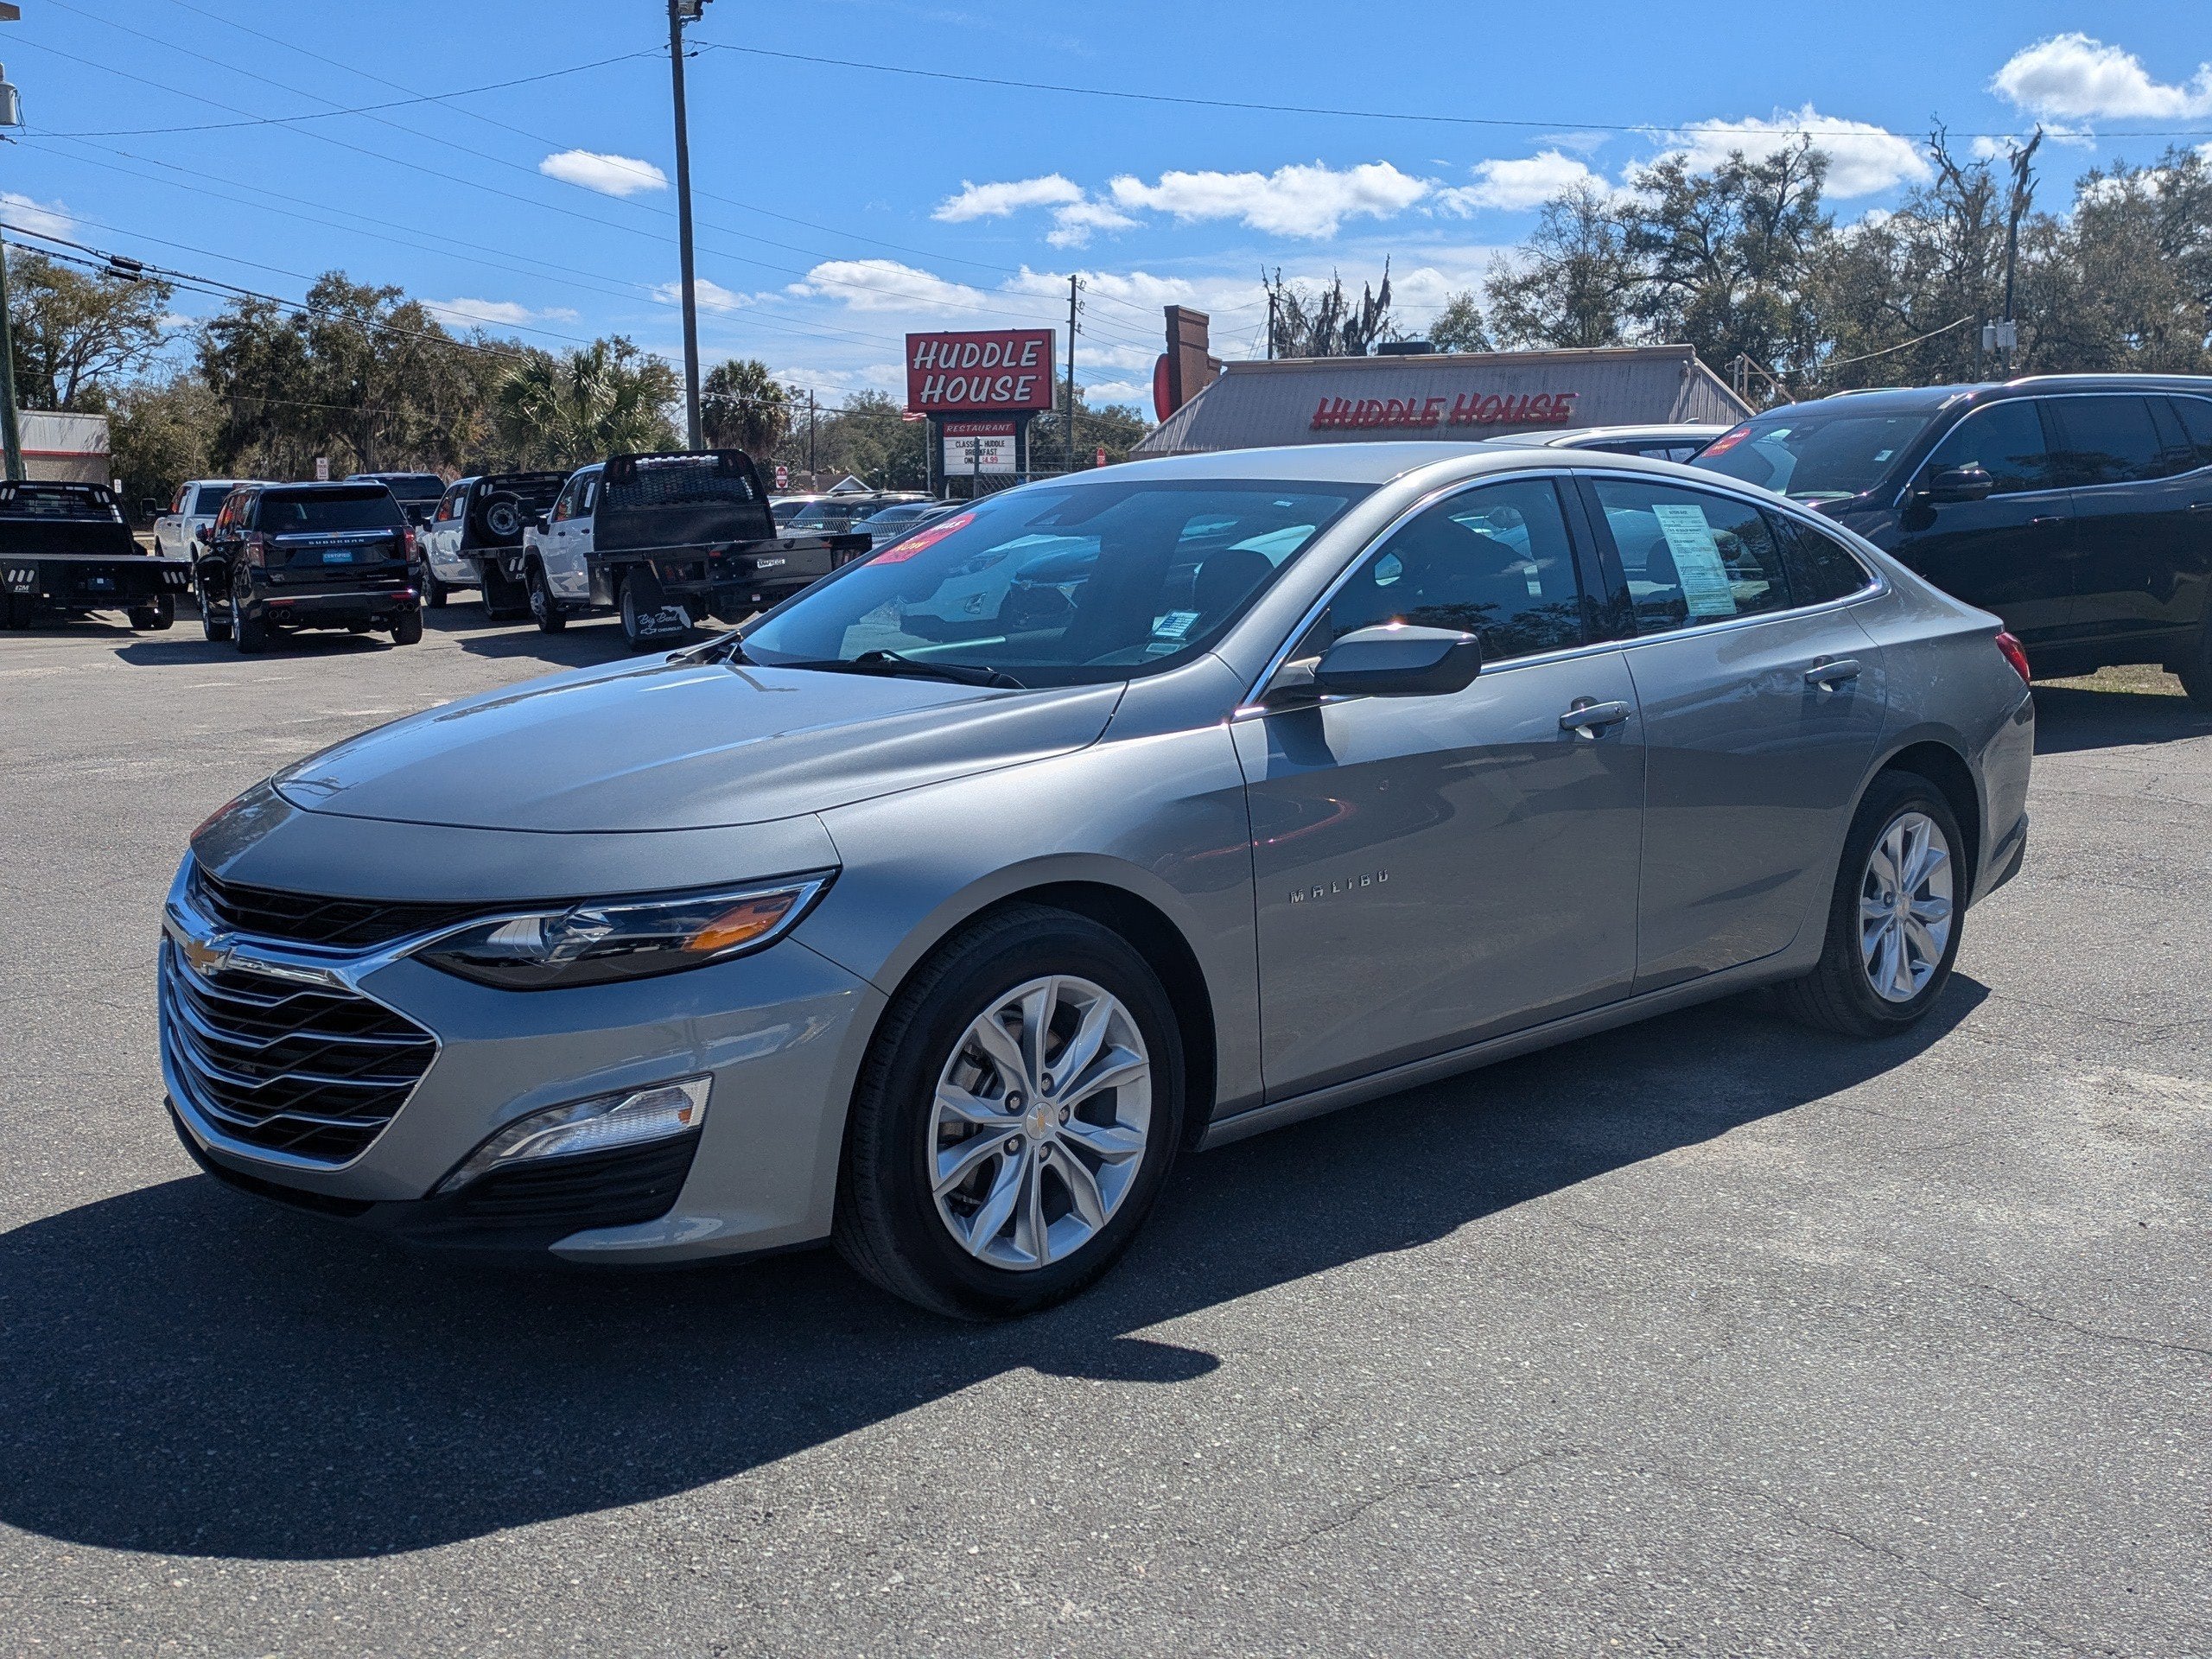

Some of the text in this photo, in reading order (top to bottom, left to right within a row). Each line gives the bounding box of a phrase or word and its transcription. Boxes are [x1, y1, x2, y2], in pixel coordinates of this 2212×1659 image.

[913, 340, 1043, 369] HUDDLE
[920, 375, 1037, 404] HOUSE
[1311, 392, 1578, 429] HUDDLE HOUSE
[947, 423, 1010, 432] RESTAURANT
[638, 613, 656, 628] Big
[1290, 868, 1389, 905] MALIBU
